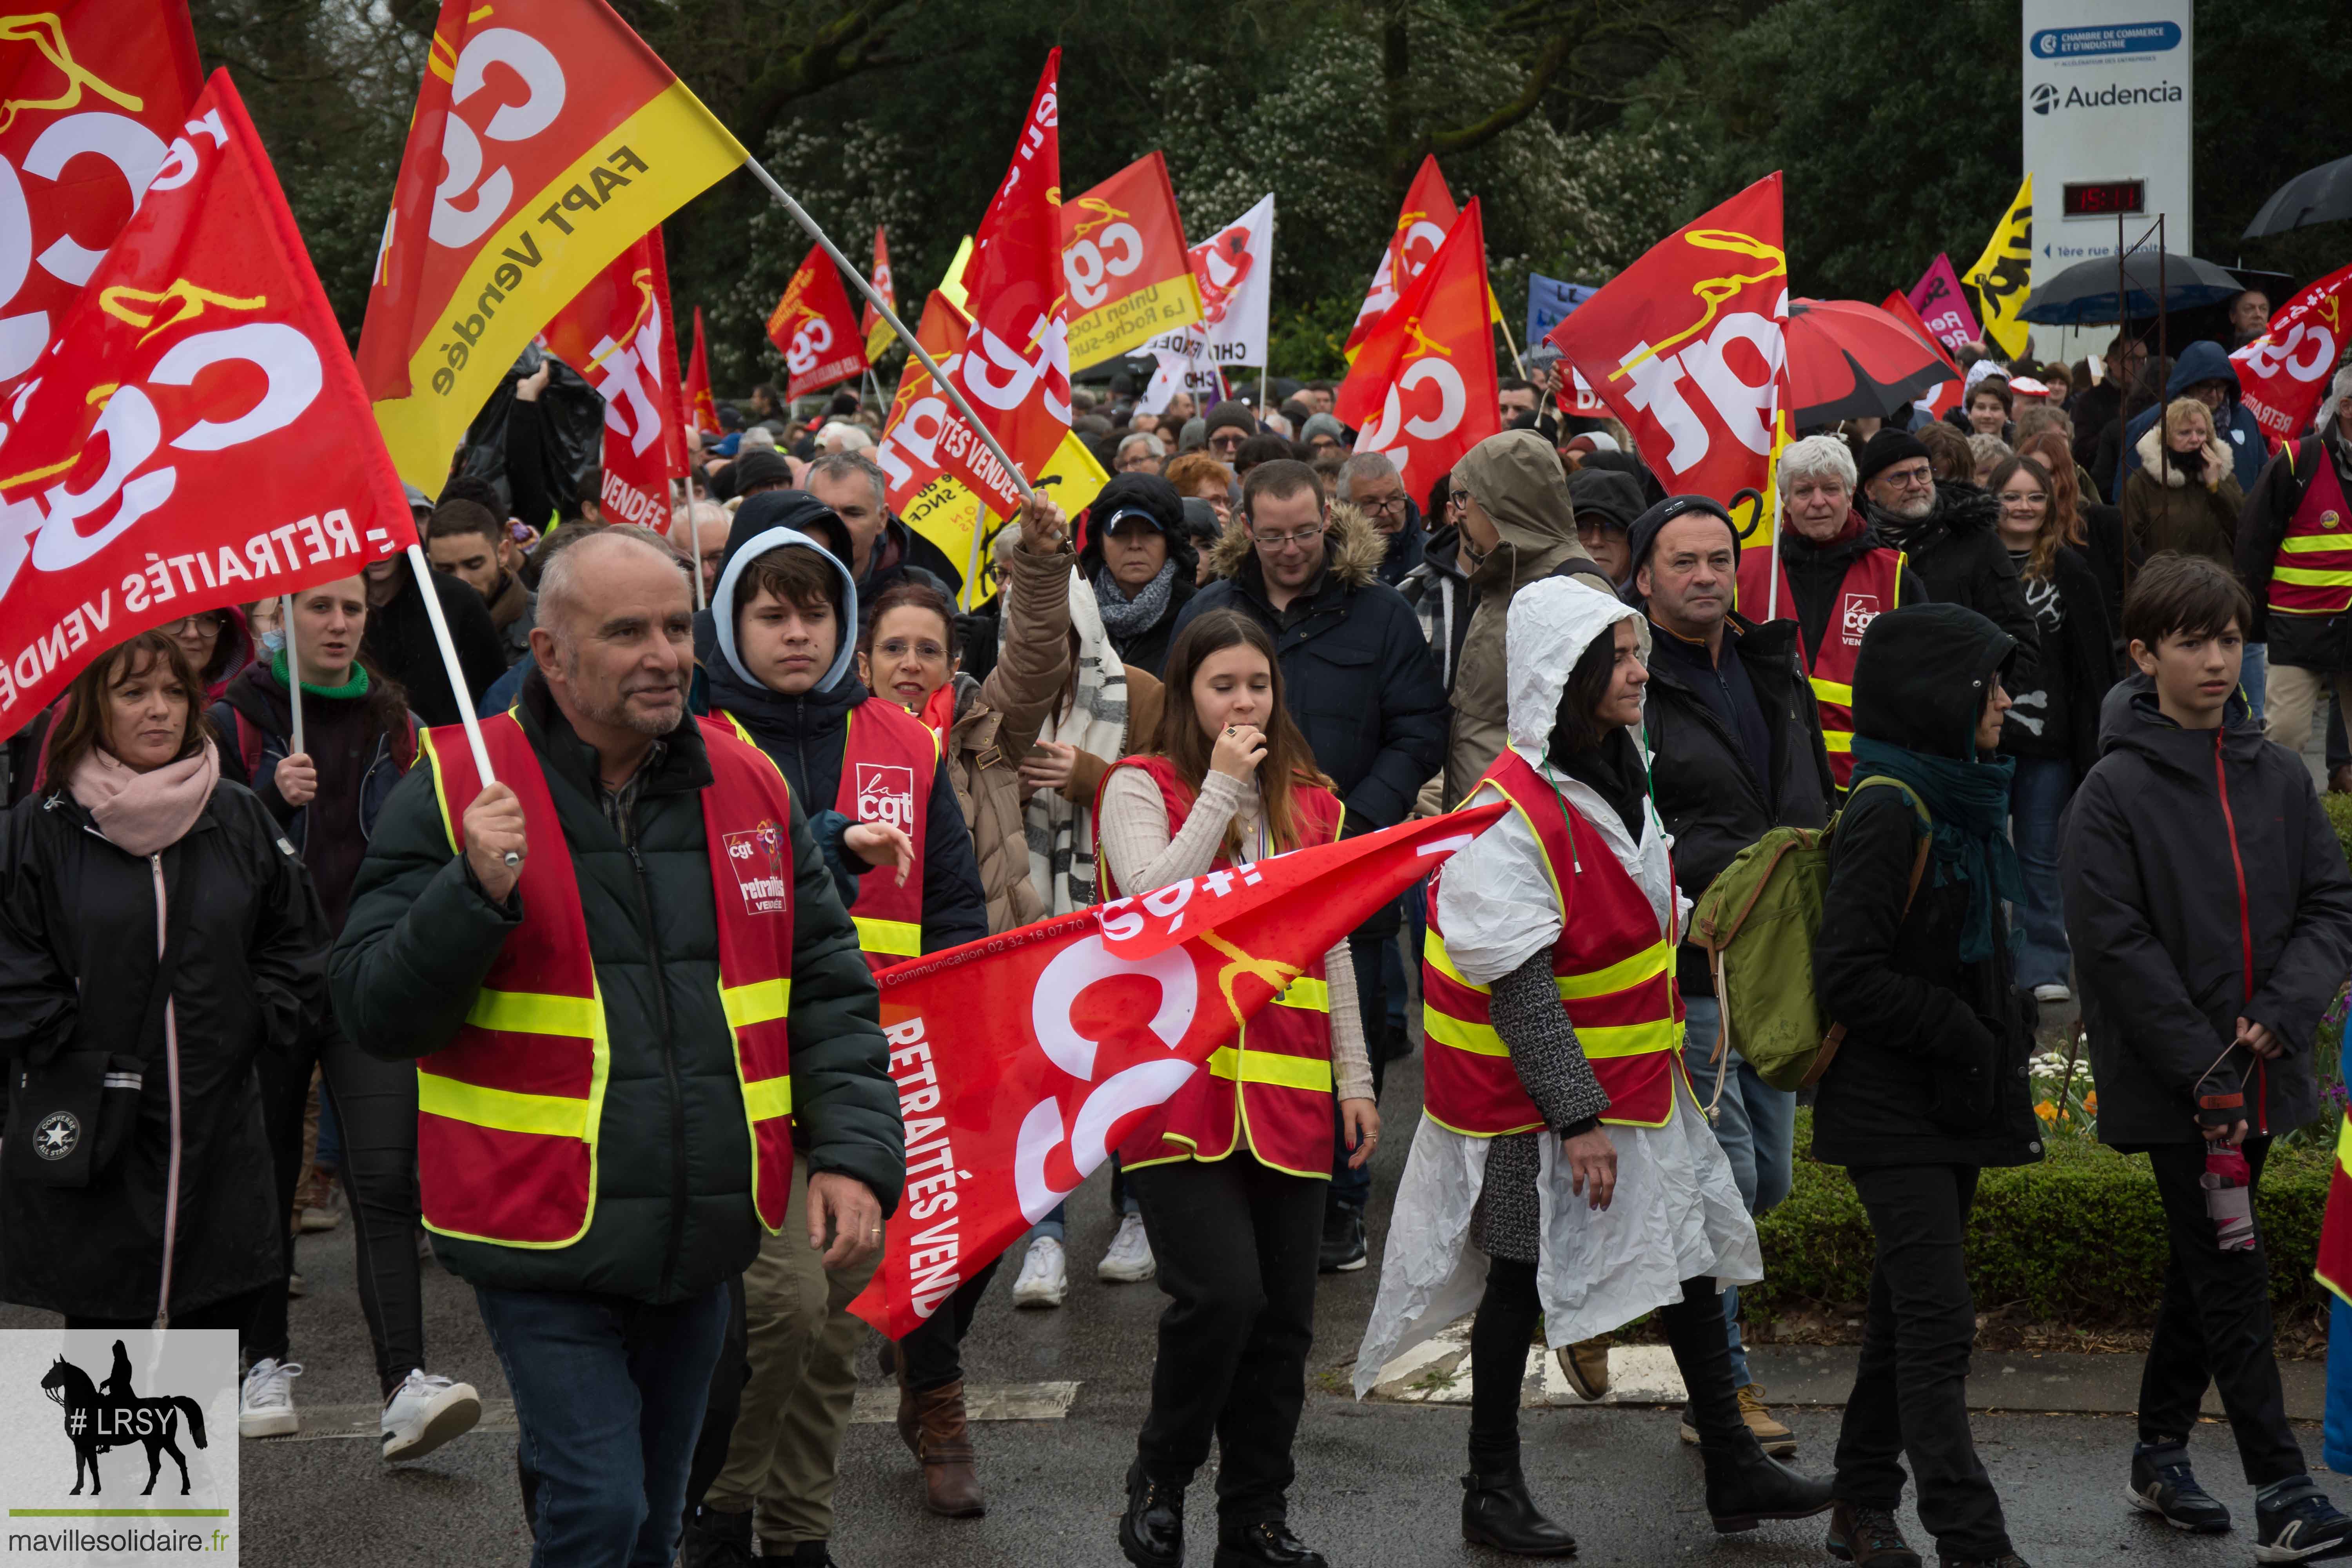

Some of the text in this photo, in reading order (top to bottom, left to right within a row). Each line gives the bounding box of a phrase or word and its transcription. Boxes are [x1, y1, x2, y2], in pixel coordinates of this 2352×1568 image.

[2061, 27, 2164, 42] CHAMBRE DE COMMERCE
[2061, 39, 2126, 52] ET D'INDUSTRIE
[2064, 80, 2182, 109] Audencia
[2081, 187, 2134, 211] 15:11
[2058, 245, 2084, 258] 1ère
[2088, 247, 2109, 257] rue
[601, 468, 667, 532] VENDÉE
[1844, 611, 1881, 634] cg
[858, 792, 913, 828] cgt
[729, 841, 754, 859] cgt
[886, 947, 985, 986] Communication
[987, 941, 1005, 953] 02
[1008, 935, 1025, 947] 32
[1029, 929, 1045, 941] 18
[1048, 924, 1063, 938] 07
[1068, 919, 1085, 932] 70
[42, 1116, 76, 1131] CONVERSE
[882, 1017, 973, 1220] RETRAITÉS
[38, 1144, 68, 1156] ALL STAR
